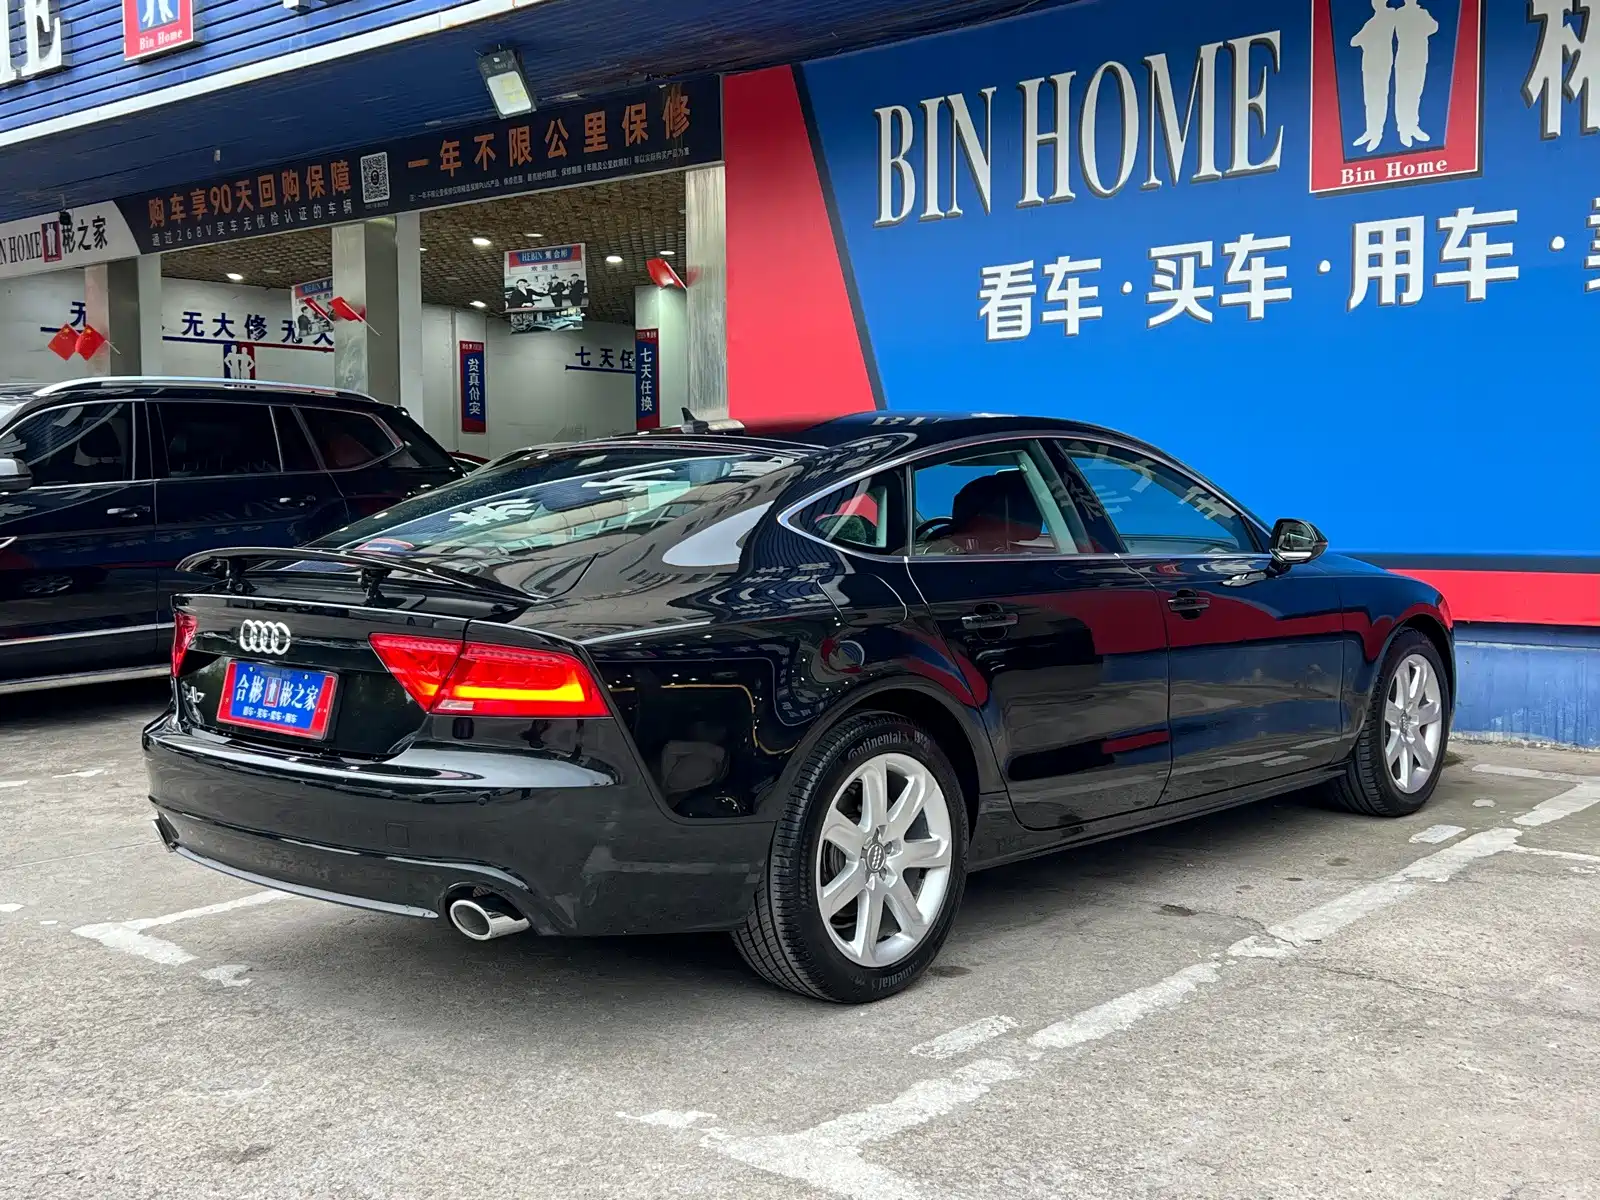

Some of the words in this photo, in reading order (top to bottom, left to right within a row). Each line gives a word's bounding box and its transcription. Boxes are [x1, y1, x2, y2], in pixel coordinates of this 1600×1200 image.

[139, 36, 155, 51] Bin
[157, 28, 184, 44] Home
[407, 92, 691, 178] 一年不限公里保修
[873, 86, 997, 228] BIN
[1014, 29, 1286, 210] HOME
[148, 159, 352, 229] 购车享90天回购保障
[1340, 167, 1377, 185] Bin
[1385, 156, 1449, 180] Home
[8, 231, 43, 263] HOME
[640, 347, 653, 412] 七天任换
[279, 680, 319, 712] 彬之家
